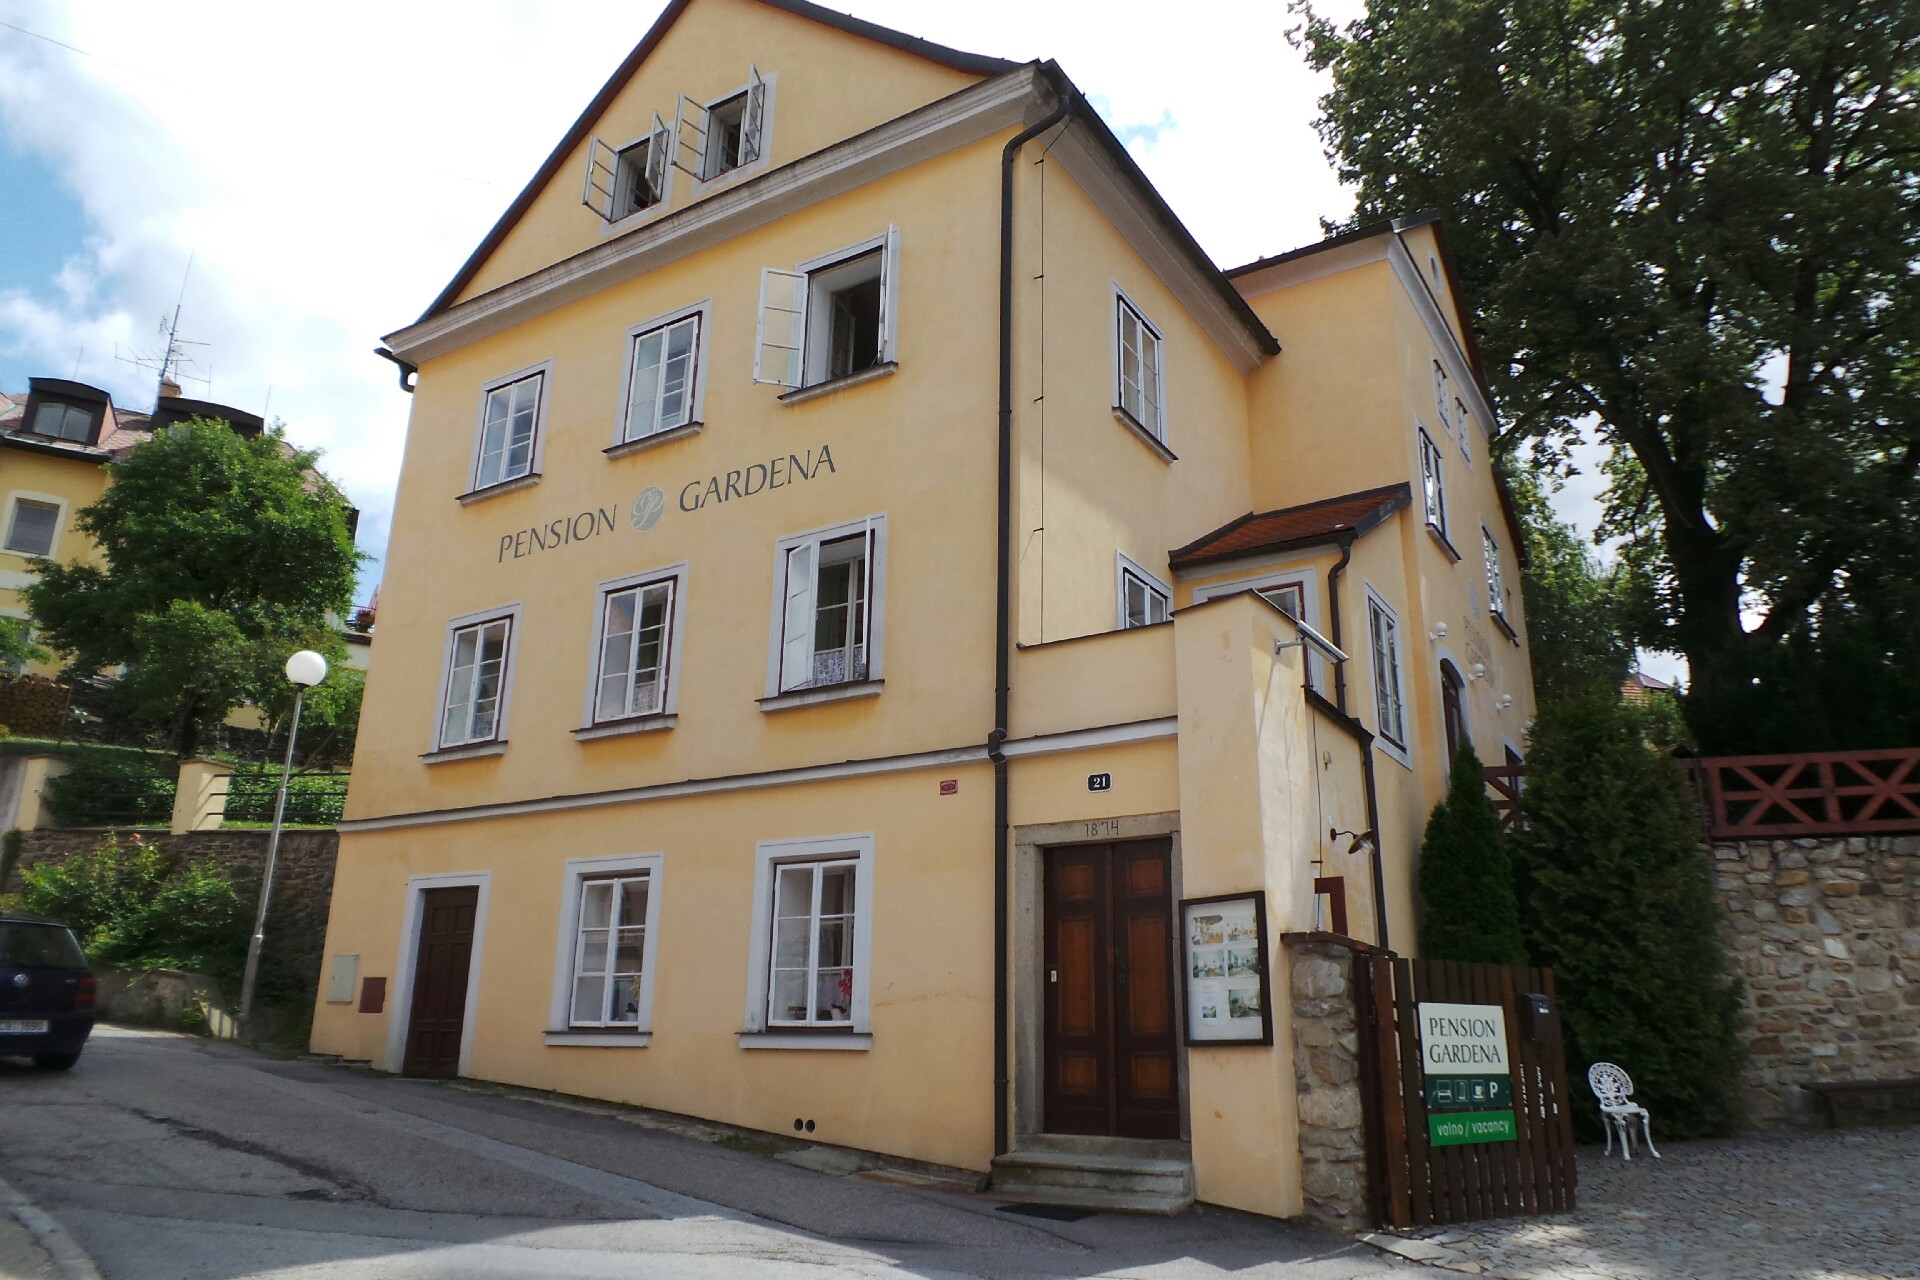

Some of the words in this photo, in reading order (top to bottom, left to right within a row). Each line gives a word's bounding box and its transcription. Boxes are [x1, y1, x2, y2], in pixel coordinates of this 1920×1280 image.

[498, 504, 617, 563] PENSION
[679, 444, 836, 512] GARDENA
[1093, 776, 1106, 788] 21
[1085, 820, 1119, 837] 1874
[1429, 1017, 1496, 1037] PENSION
[1429, 1044, 1502, 1063] GARDENA
[1437, 1122, 1464, 1136] volno
[1471, 1119, 1509, 1134] vacancy
